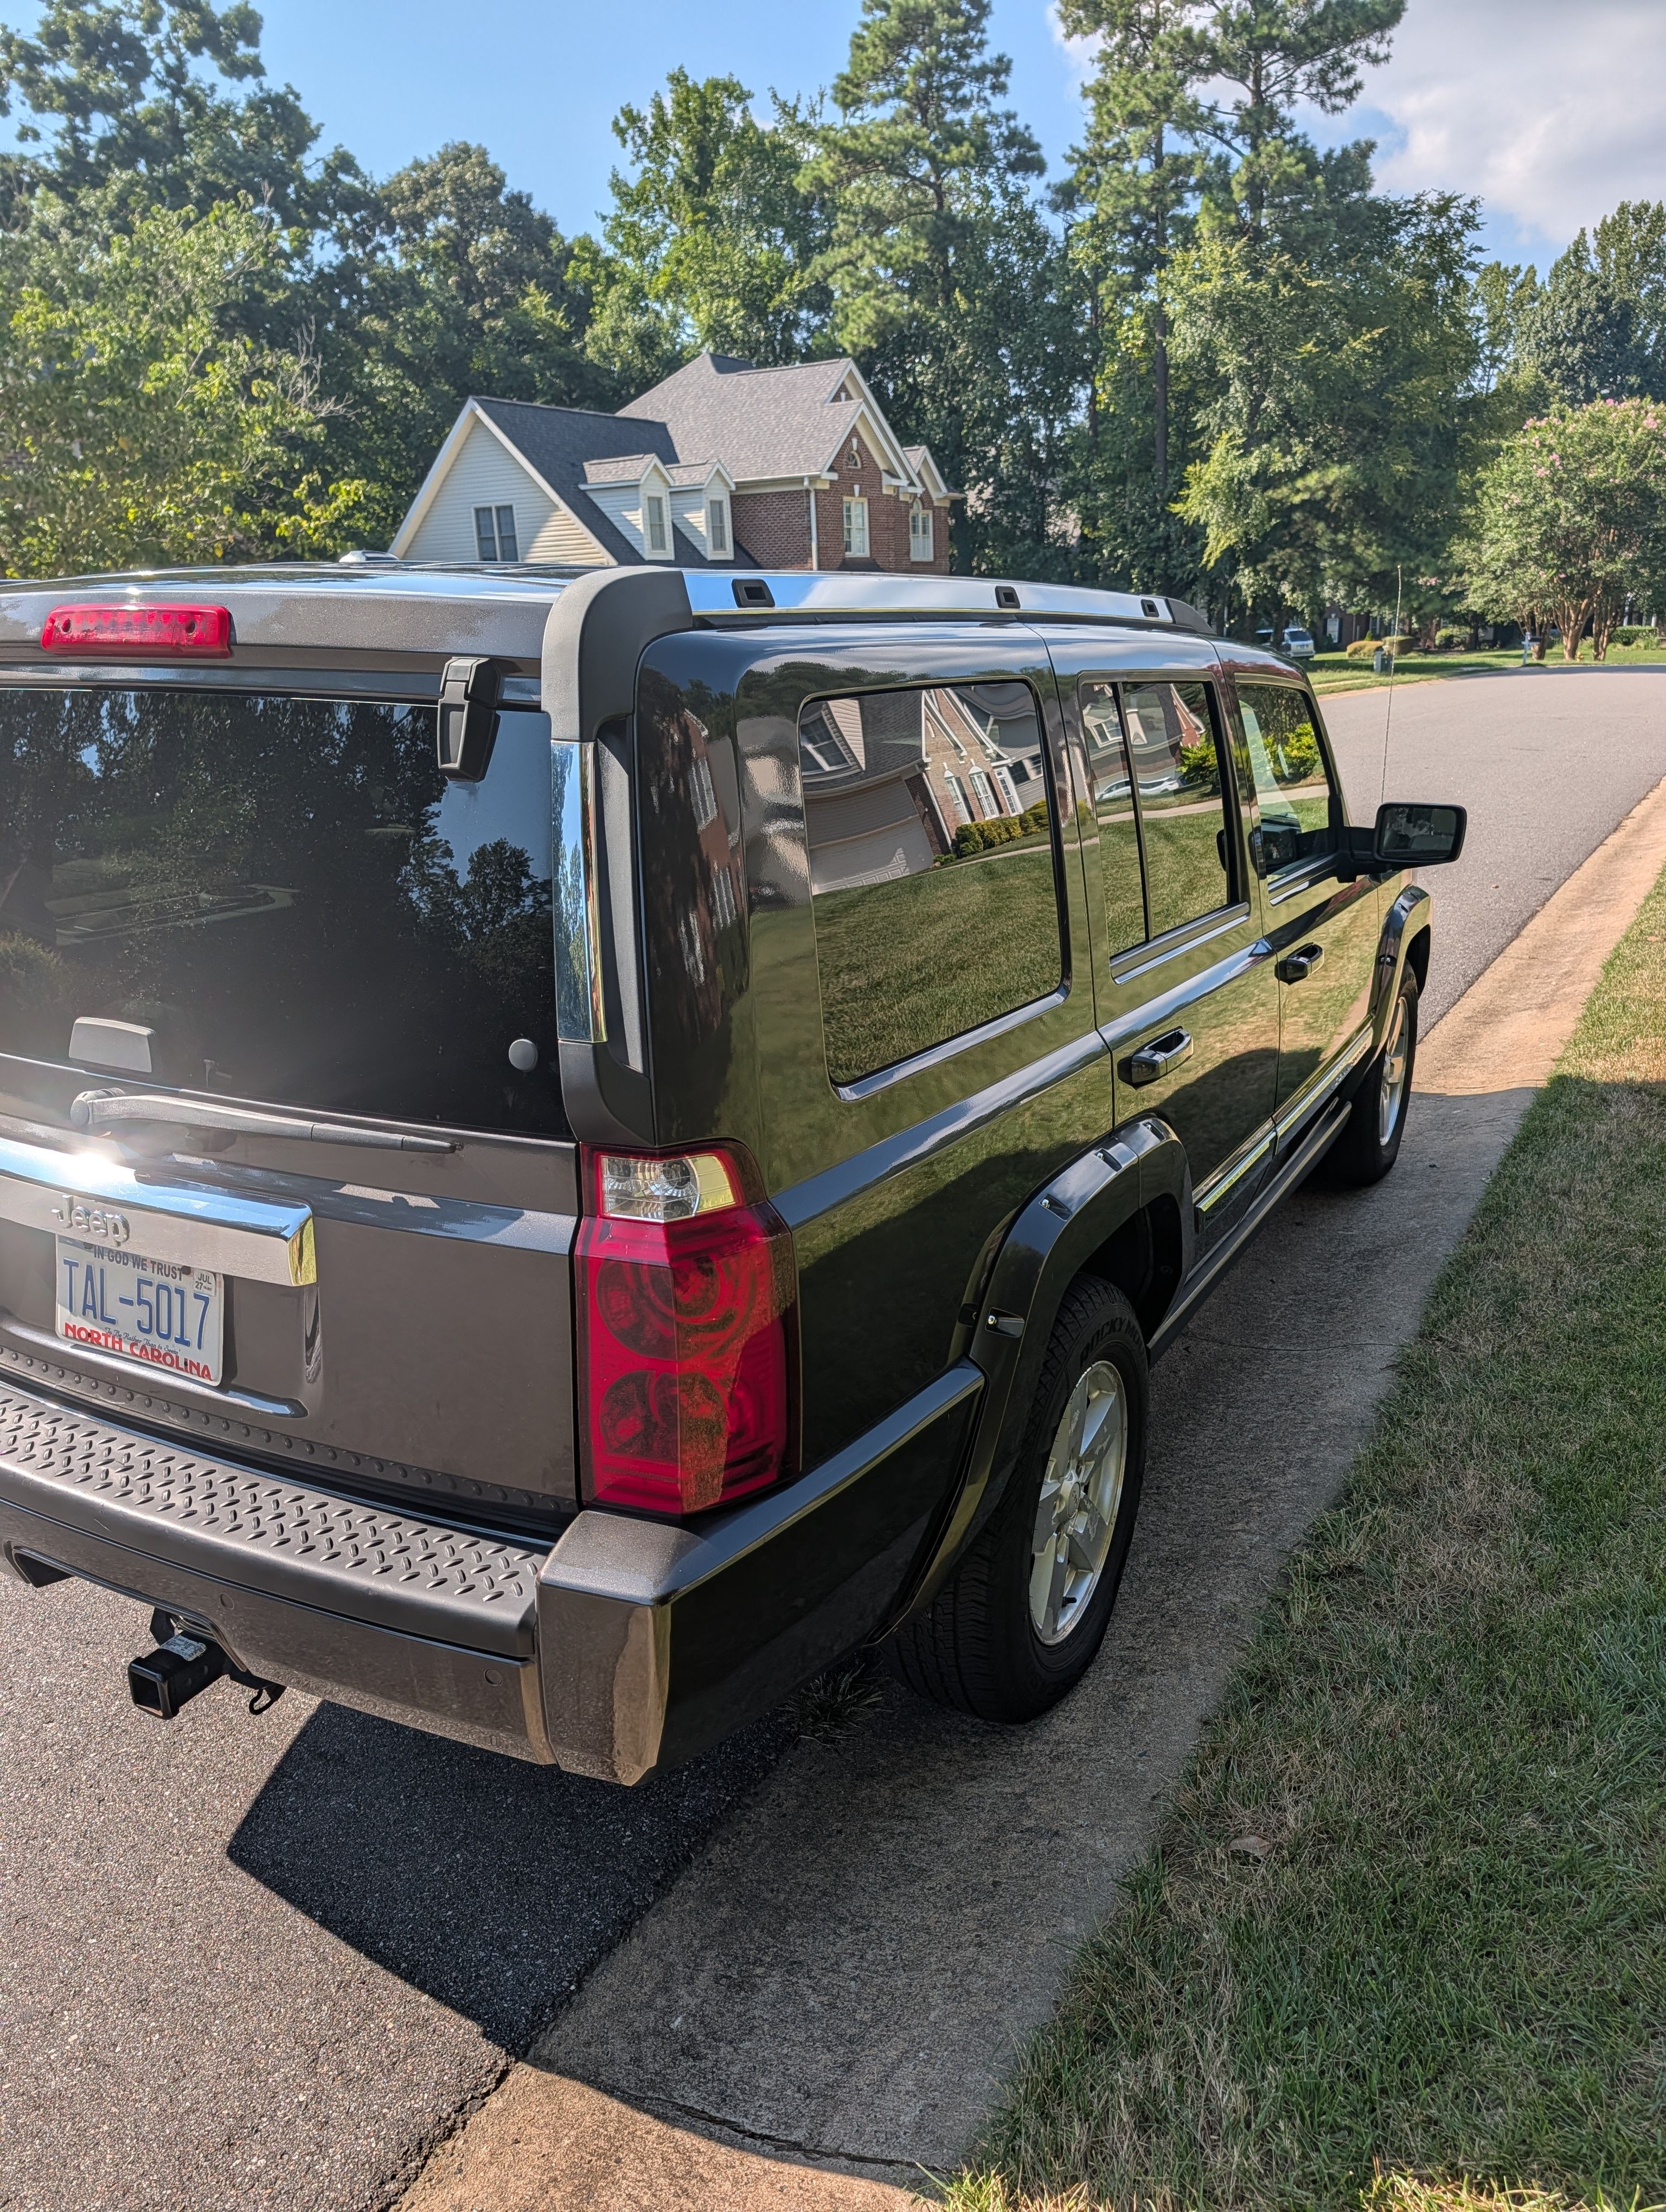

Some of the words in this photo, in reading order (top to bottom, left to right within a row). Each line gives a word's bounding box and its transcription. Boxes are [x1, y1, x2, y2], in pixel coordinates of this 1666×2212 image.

[52, 1194, 131, 1247] Jeep
[94, 1246, 104, 1259] IN
[107, 1249, 129, 1266] GOD
[132, 1255, 148, 1271] WE
[150, 1261, 183, 1281] TRUST
[198, 1273, 212, 1284] JUL
[63, 1257, 210, 1350] TAL-5017
[195, 1281, 203, 1290] 27
[65, 1322, 123, 1352] NORTH
[130, 1342, 213, 1381] CAROLINA
[114, 1329, 122, 1338] Be
[123, 1332, 142, 1343] Rather
[143, 1338, 156, 1348] Than
[1080, 1317, 1127, 1369] ROCKY
